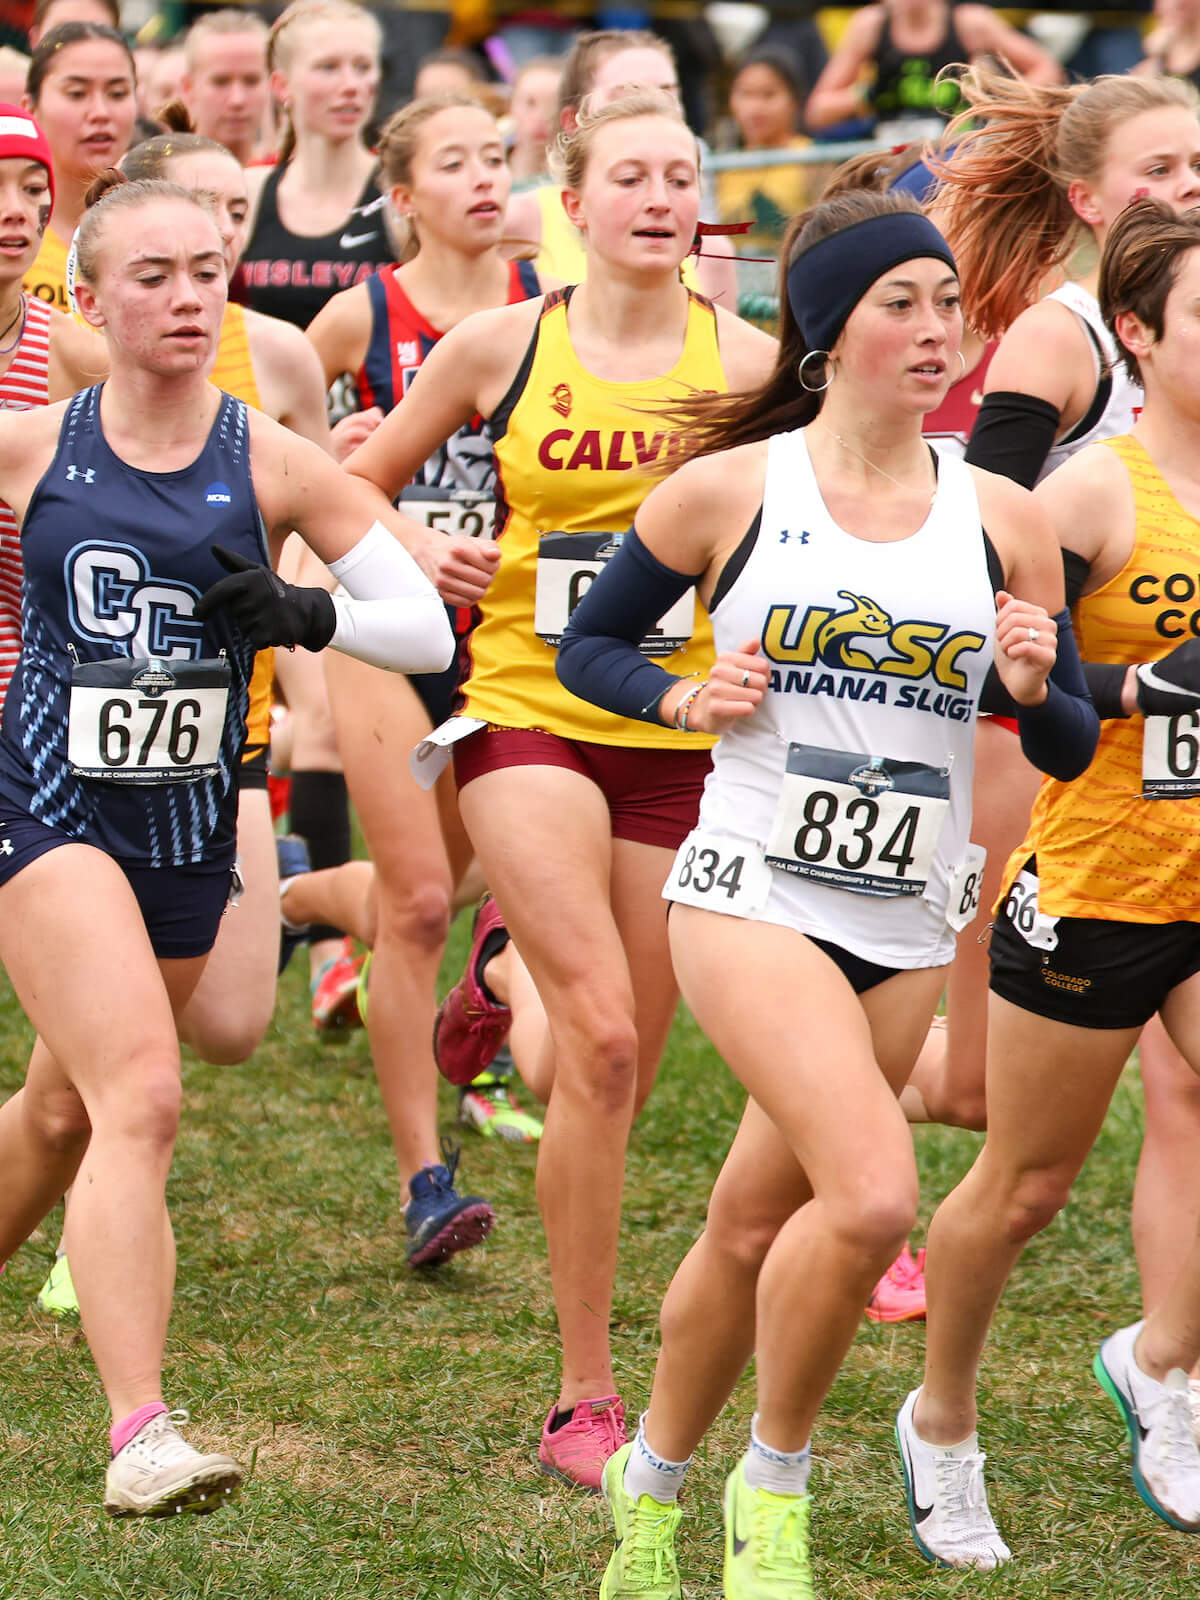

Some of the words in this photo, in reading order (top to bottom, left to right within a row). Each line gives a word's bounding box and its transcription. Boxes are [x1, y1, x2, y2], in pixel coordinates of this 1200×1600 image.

[64, 539, 205, 660] CC
[768, 670, 887, 705] ANANA
[99, 699, 201, 767] 676
[794, 790, 921, 877] 834
[678, 845, 745, 898] 834
[1041, 967, 1092, 987] COLORADO
[1044, 976, 1085, 993] COLLEGE
